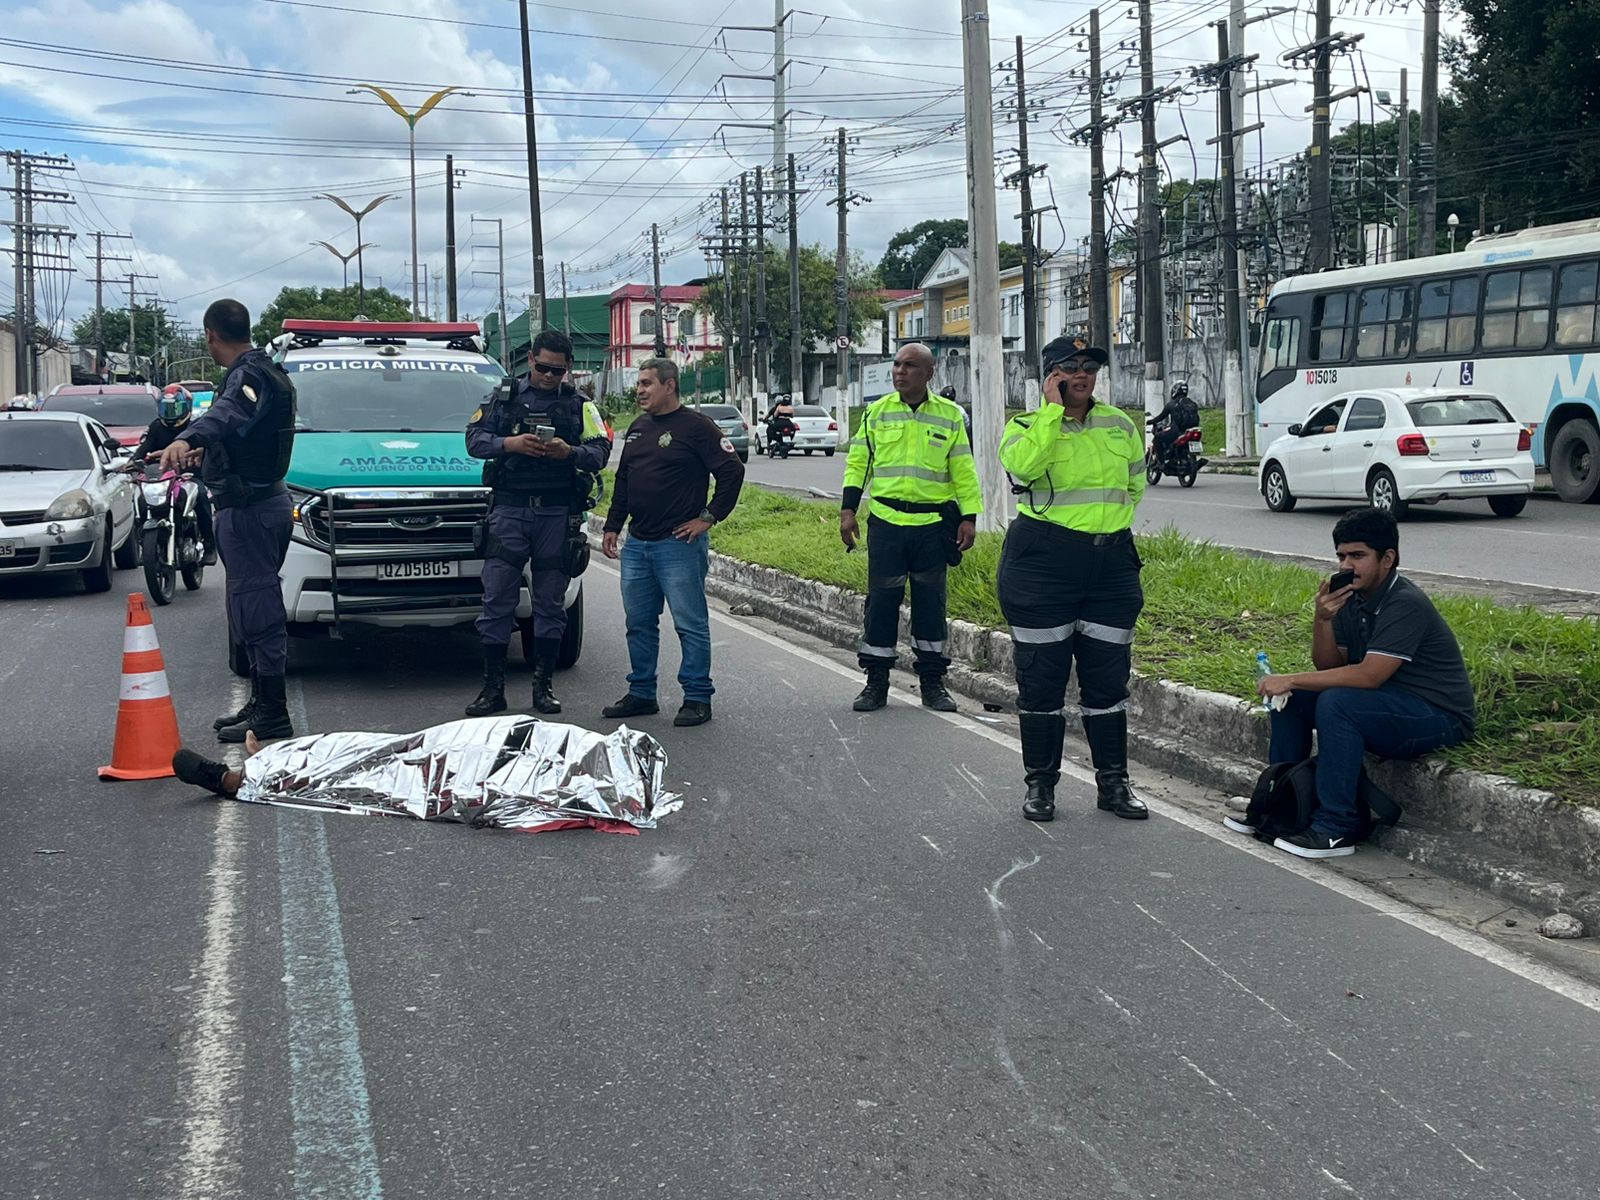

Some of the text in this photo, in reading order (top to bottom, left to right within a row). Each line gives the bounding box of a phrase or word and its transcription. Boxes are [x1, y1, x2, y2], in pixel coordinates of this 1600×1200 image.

[300, 360, 478, 374] POLÍCIA MILITAR
[1306, 370, 1338, 384] 1015018
[339, 456, 479, 466] AMAZONAS
[428, 464, 471, 472] ESTADO
